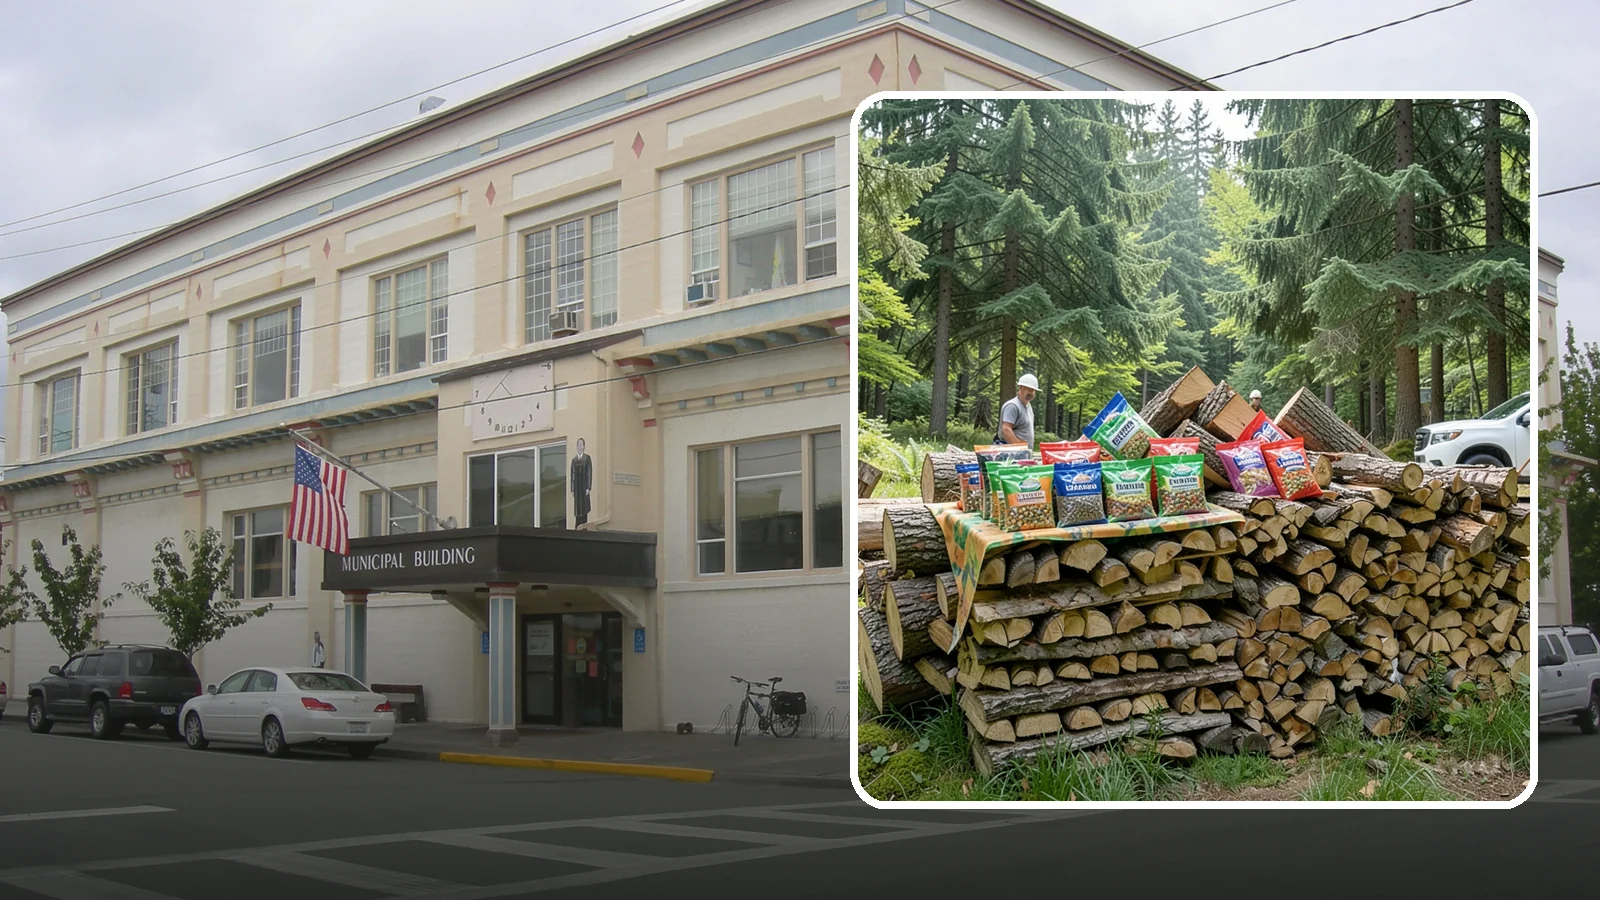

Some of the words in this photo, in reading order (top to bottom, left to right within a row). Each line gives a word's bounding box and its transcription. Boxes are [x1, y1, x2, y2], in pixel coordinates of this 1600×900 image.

[475, 390, 479, 398] 7
[536, 402, 540, 410] 4
[480, 407, 485, 415] 8
[487, 417, 492, 426] 9
[529, 414, 533, 422] 3
[494, 423, 500, 432] 10
[521, 420, 525, 428] 2
[501, 425, 506, 433] 11
[507, 425, 513, 433] 12
[341, 552, 406, 572] MUNICIPAL
[414, 546, 475, 567] BUILDING
